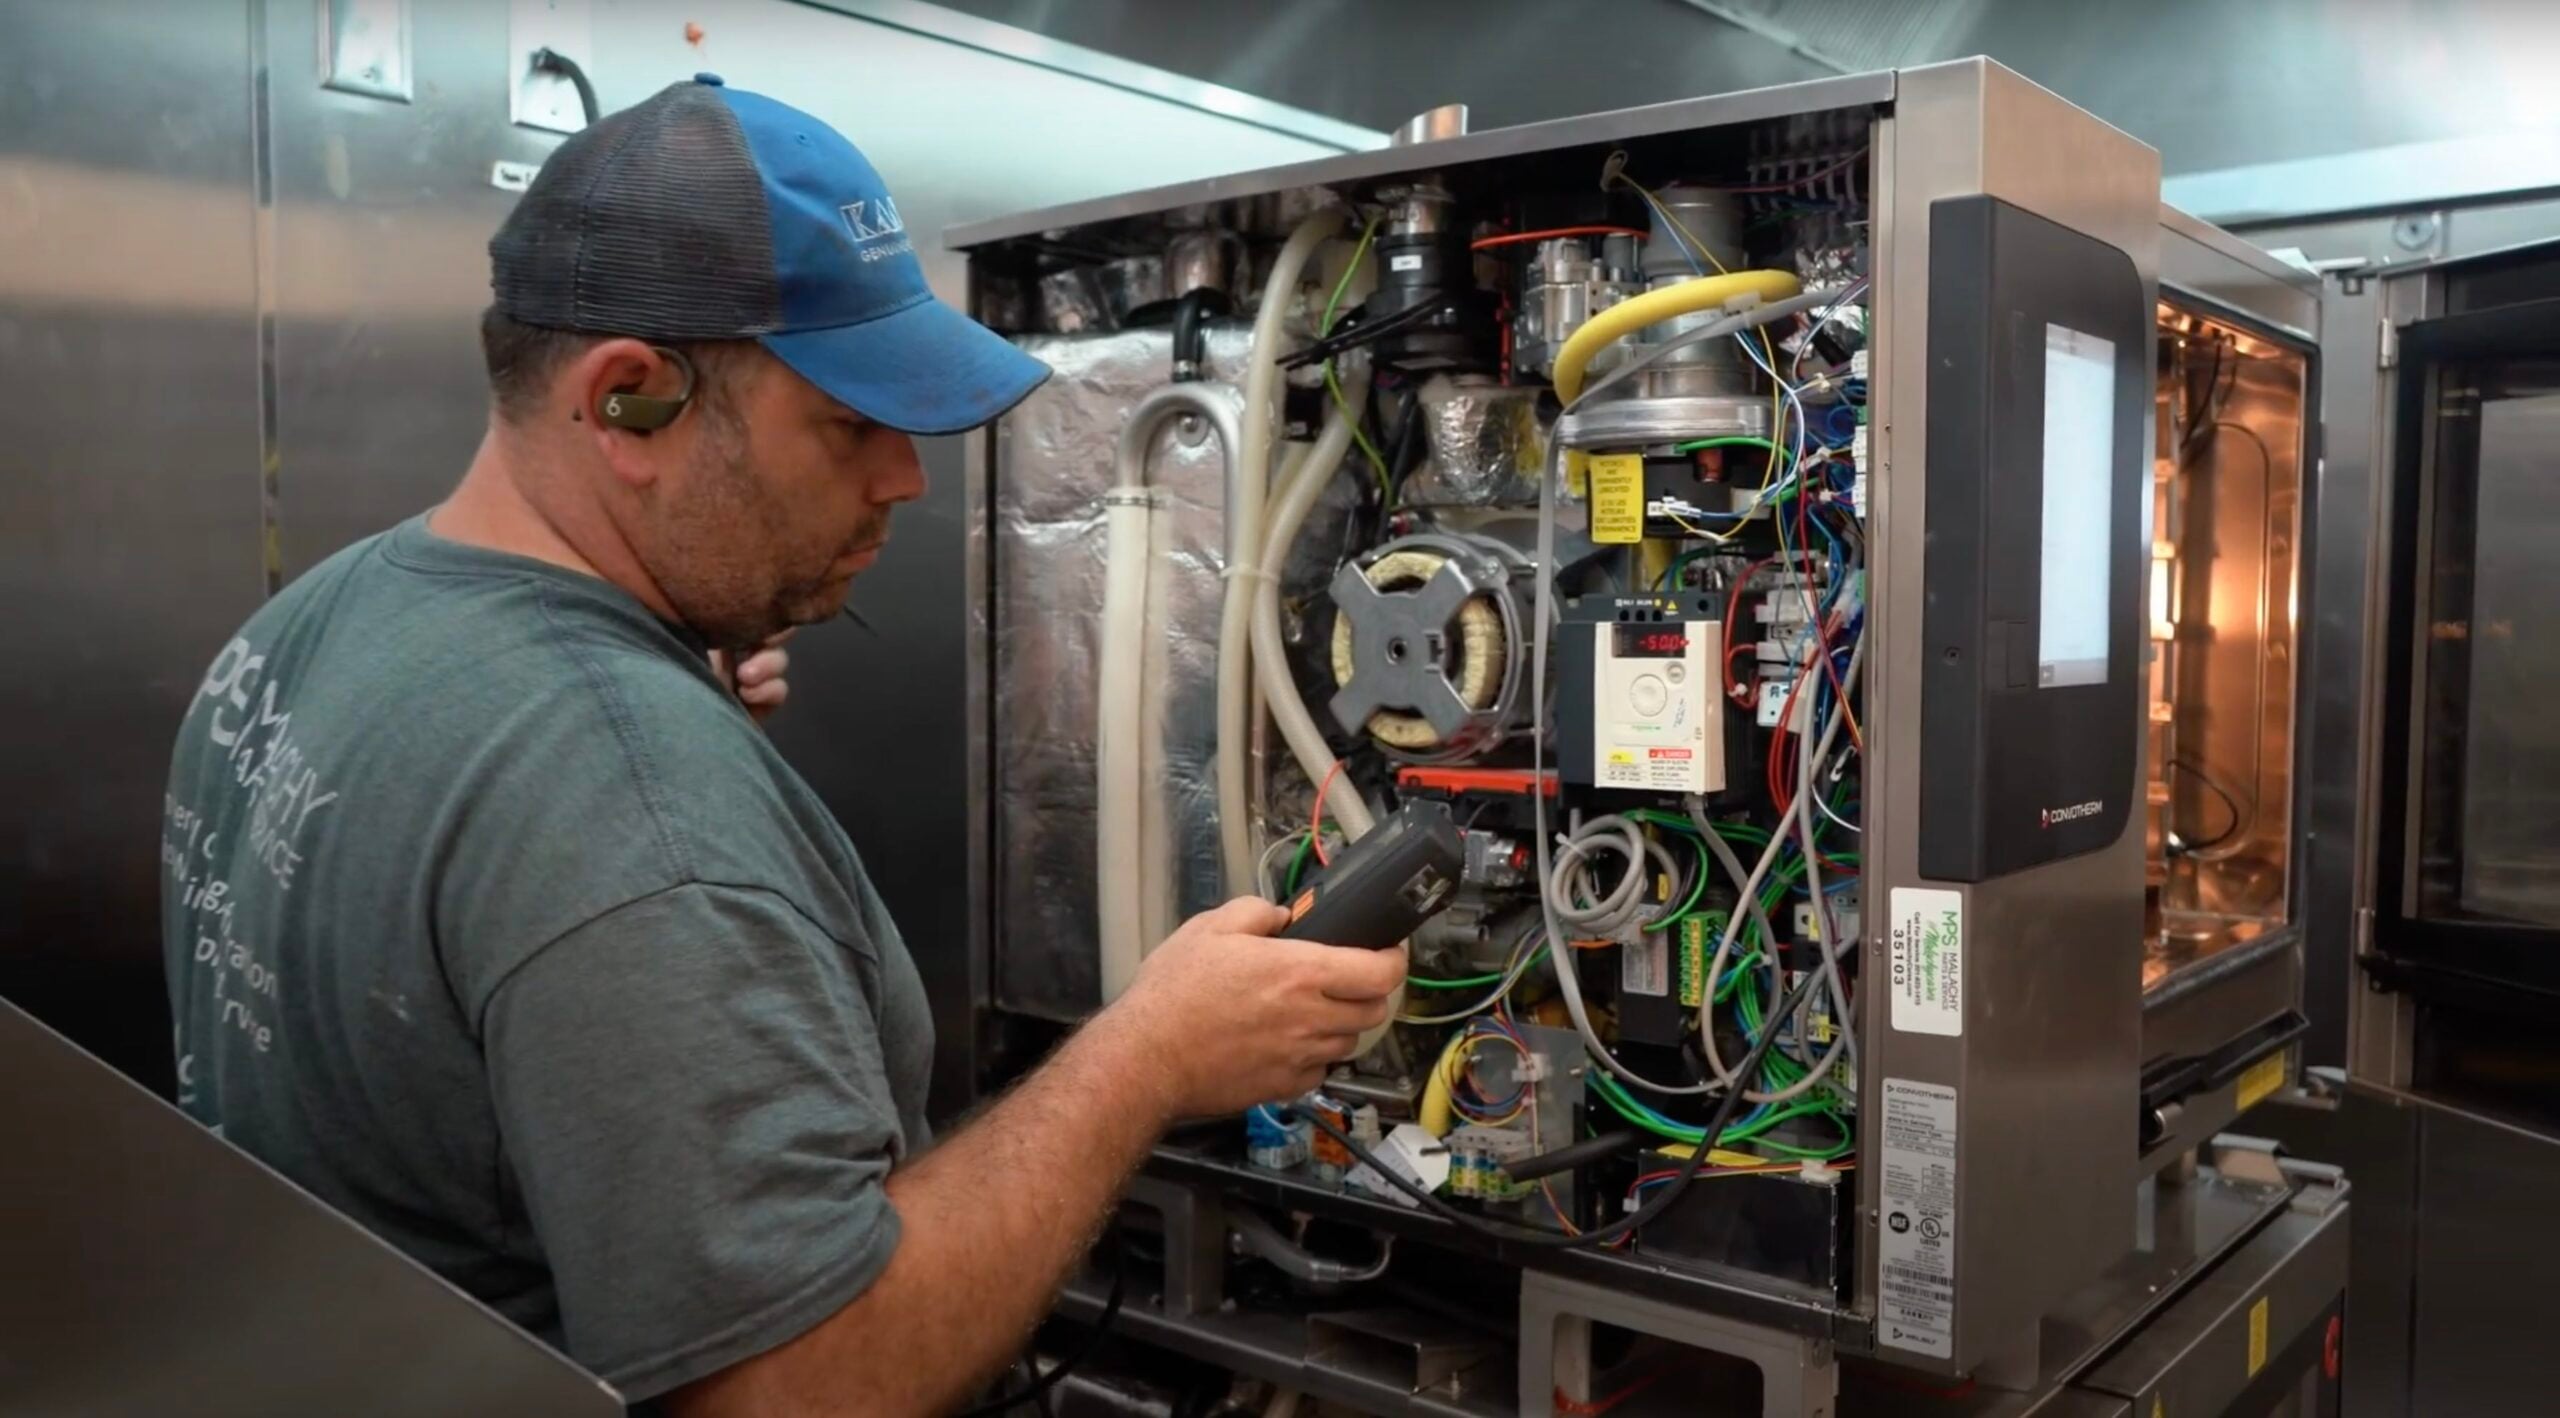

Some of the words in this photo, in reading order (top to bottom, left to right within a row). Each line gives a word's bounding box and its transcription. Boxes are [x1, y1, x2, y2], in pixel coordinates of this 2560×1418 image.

[2050, 800, 2103, 823] CONVOTHERM
[1942, 910, 1958, 947] MPS
[1893, 929, 1905, 986] 35103
[1948, 952, 1959, 1012] MALACHY
